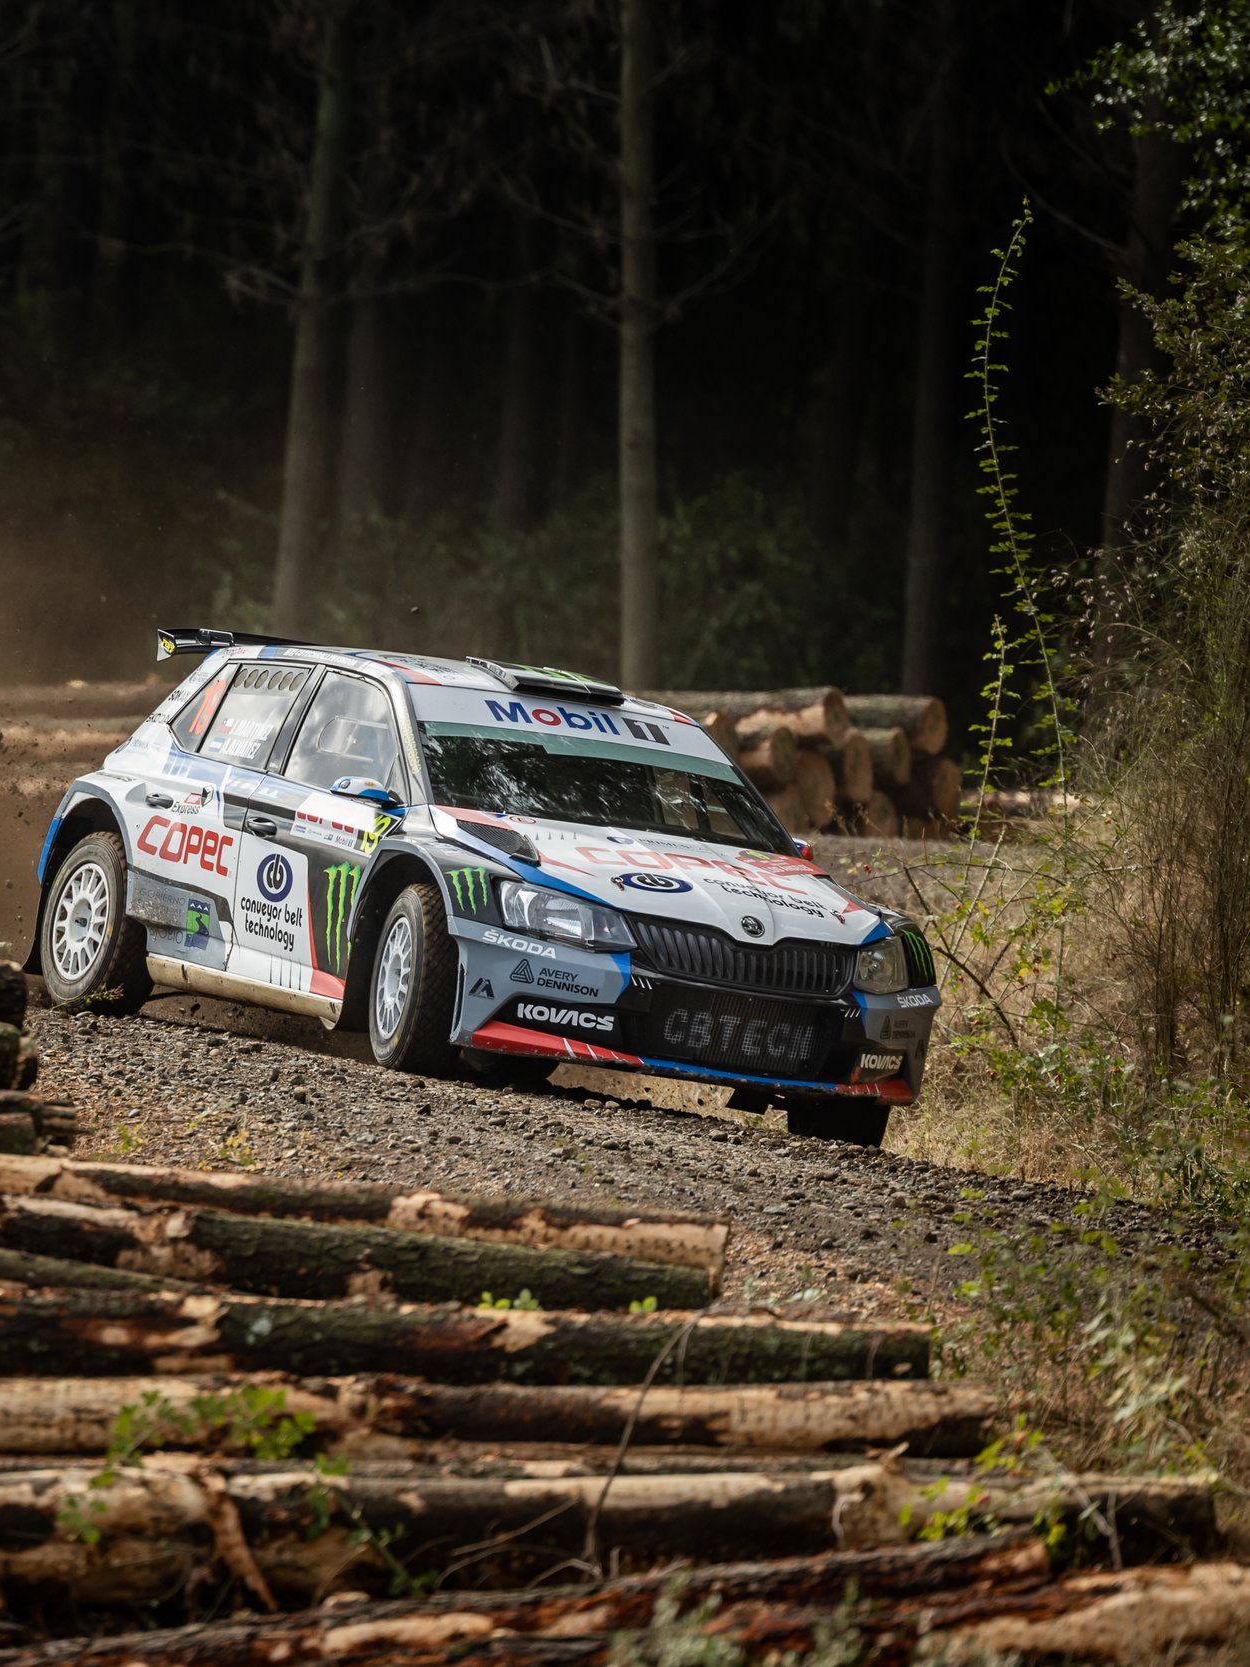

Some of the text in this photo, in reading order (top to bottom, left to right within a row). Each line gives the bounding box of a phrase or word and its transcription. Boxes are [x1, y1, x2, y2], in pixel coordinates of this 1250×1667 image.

[484, 699, 621, 736] Mobil
[171, 803, 200, 815] Express
[240, 896, 303, 928] conveyor belt
[244, 913, 295, 952] technology
[482, 929, 557, 960] ŠKODA
[537, 977, 599, 998] DENNISON
[539, 967, 579, 982] AVERY
[896, 993, 934, 1008] ŠKODA
[516, 1003, 615, 1032] KOVACS
[663, 1008, 814, 1061] CBTECH
[860, 1053, 904, 1070] KOVACS
